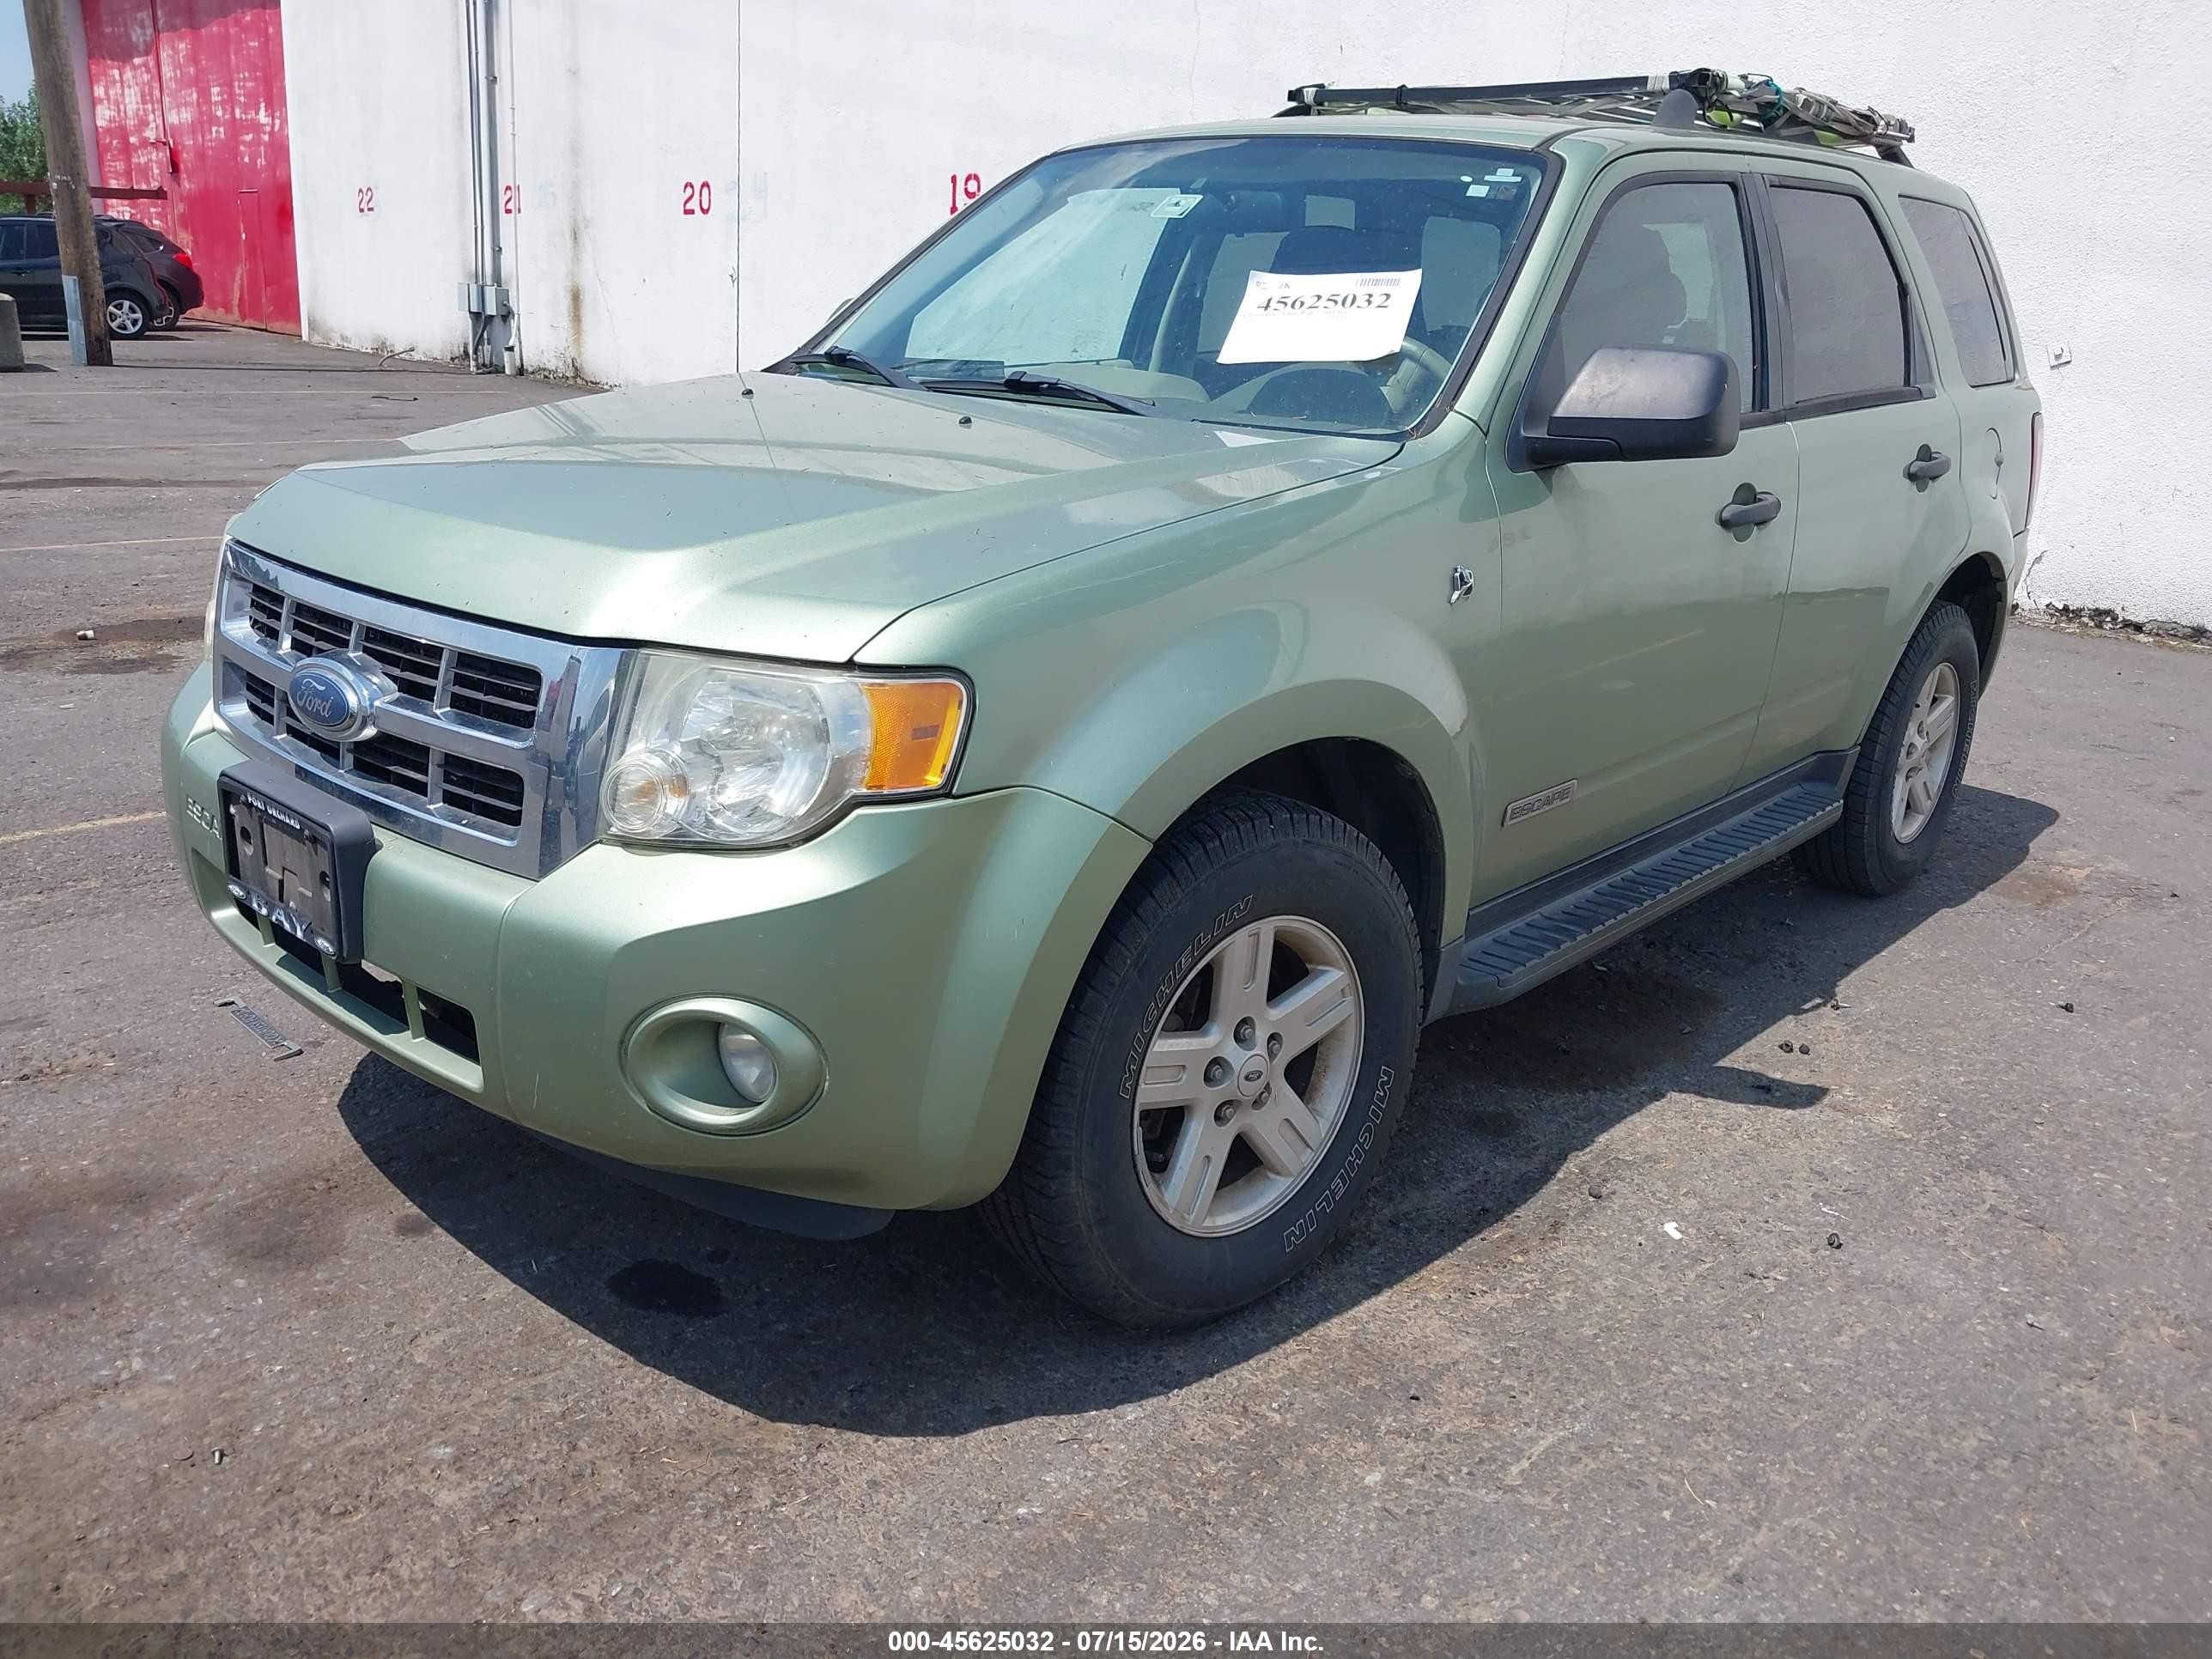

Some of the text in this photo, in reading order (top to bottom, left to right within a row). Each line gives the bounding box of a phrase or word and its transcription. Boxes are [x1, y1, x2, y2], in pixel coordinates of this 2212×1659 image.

[357, 186, 375, 214] 22
[503, 185, 521, 215] 21
[683, 180, 711, 216] 20
[949, 173, 981, 216] 19
[1256, 292, 1392, 312] 45625032
[296, 678, 334, 718] Ford
[186, 797, 222, 840] ESCA
[1510, 786, 1572, 821] ESCAPE
[252, 892, 312, 940] BAY
[1120, 895, 1254, 1099] MICHELIN
[1283, 1066, 1395, 1252] MICHELIN
